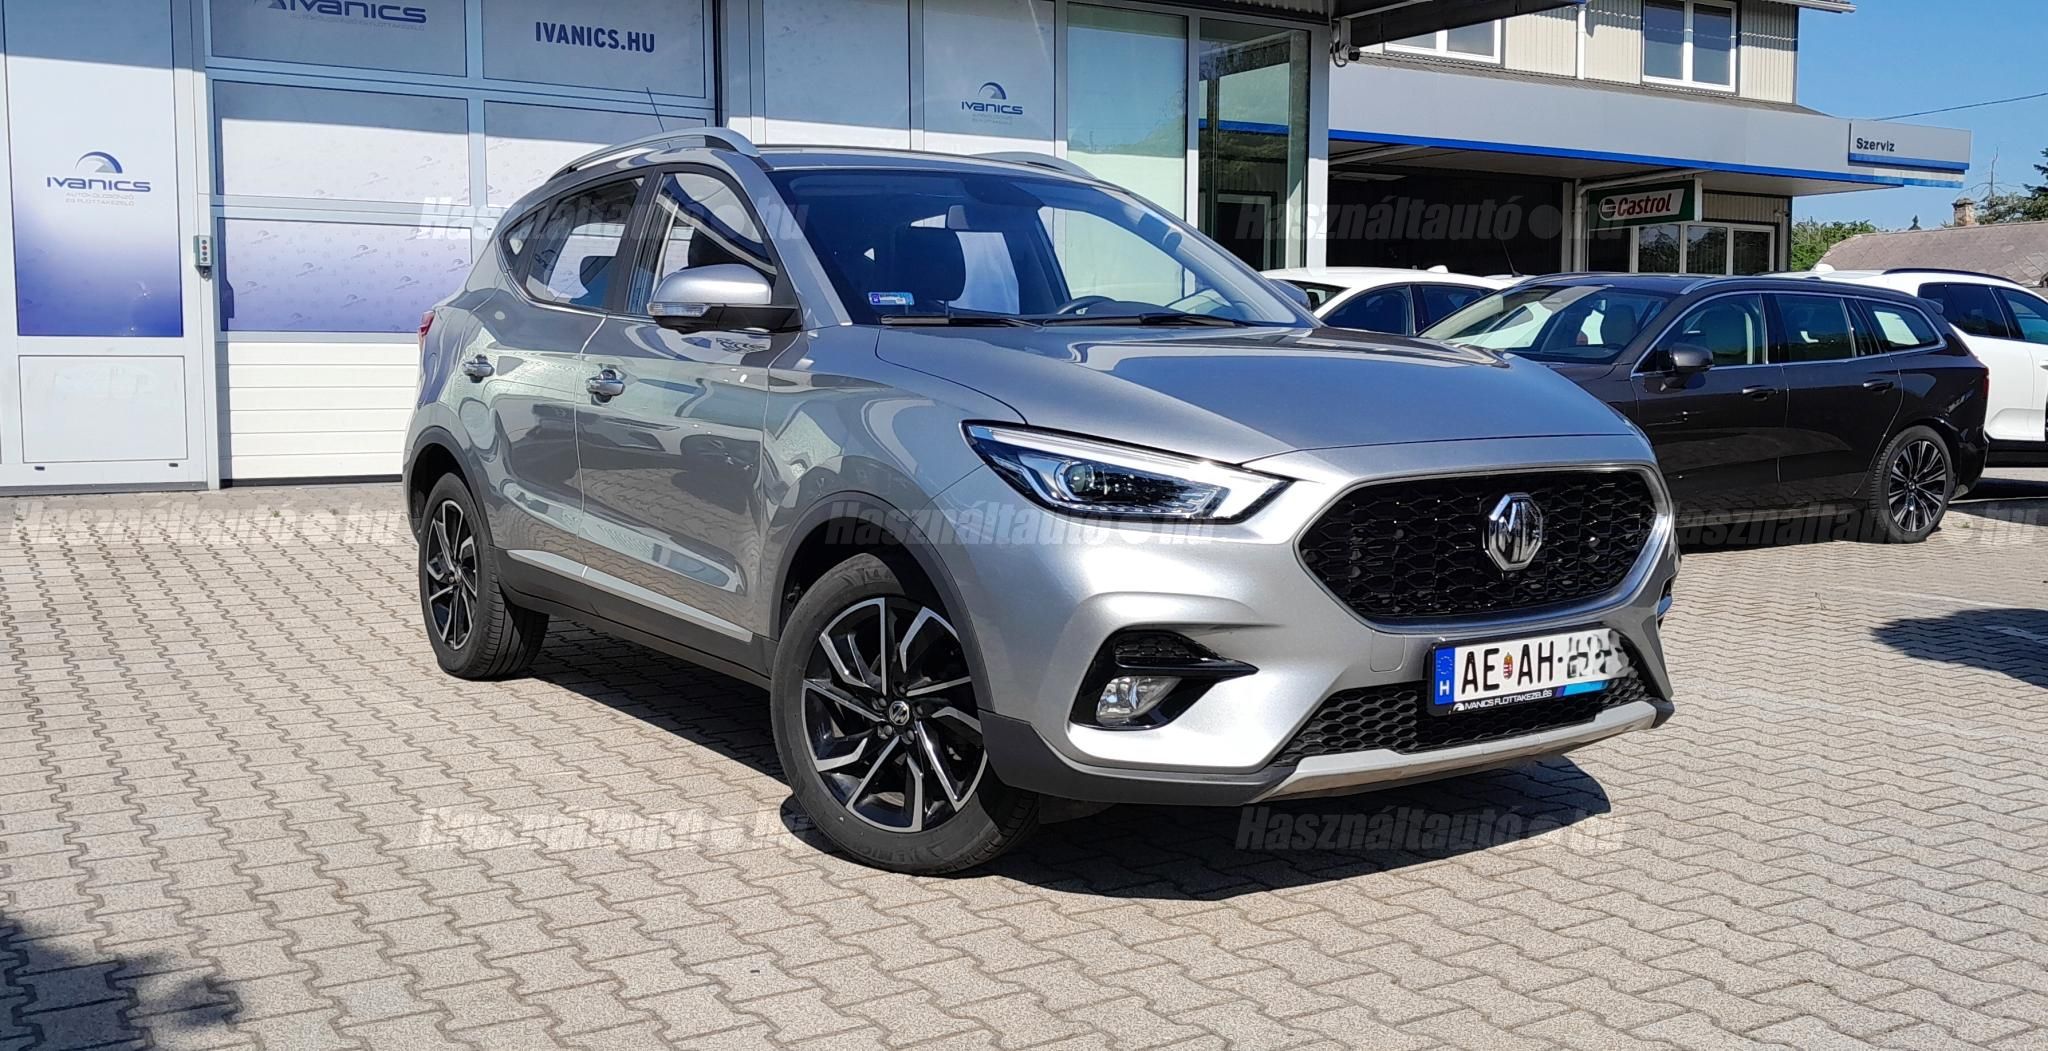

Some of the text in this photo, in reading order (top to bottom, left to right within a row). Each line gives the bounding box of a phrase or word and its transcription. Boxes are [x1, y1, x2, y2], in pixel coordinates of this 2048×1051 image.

[535, 22, 655, 53] IVANICS.HU
[1856, 138, 1895, 152] Szerviz
[1617, 193, 1672, 216] Castrol
[1462, 647, 1500, 694] AE
[1440, 680, 1450, 696] H
